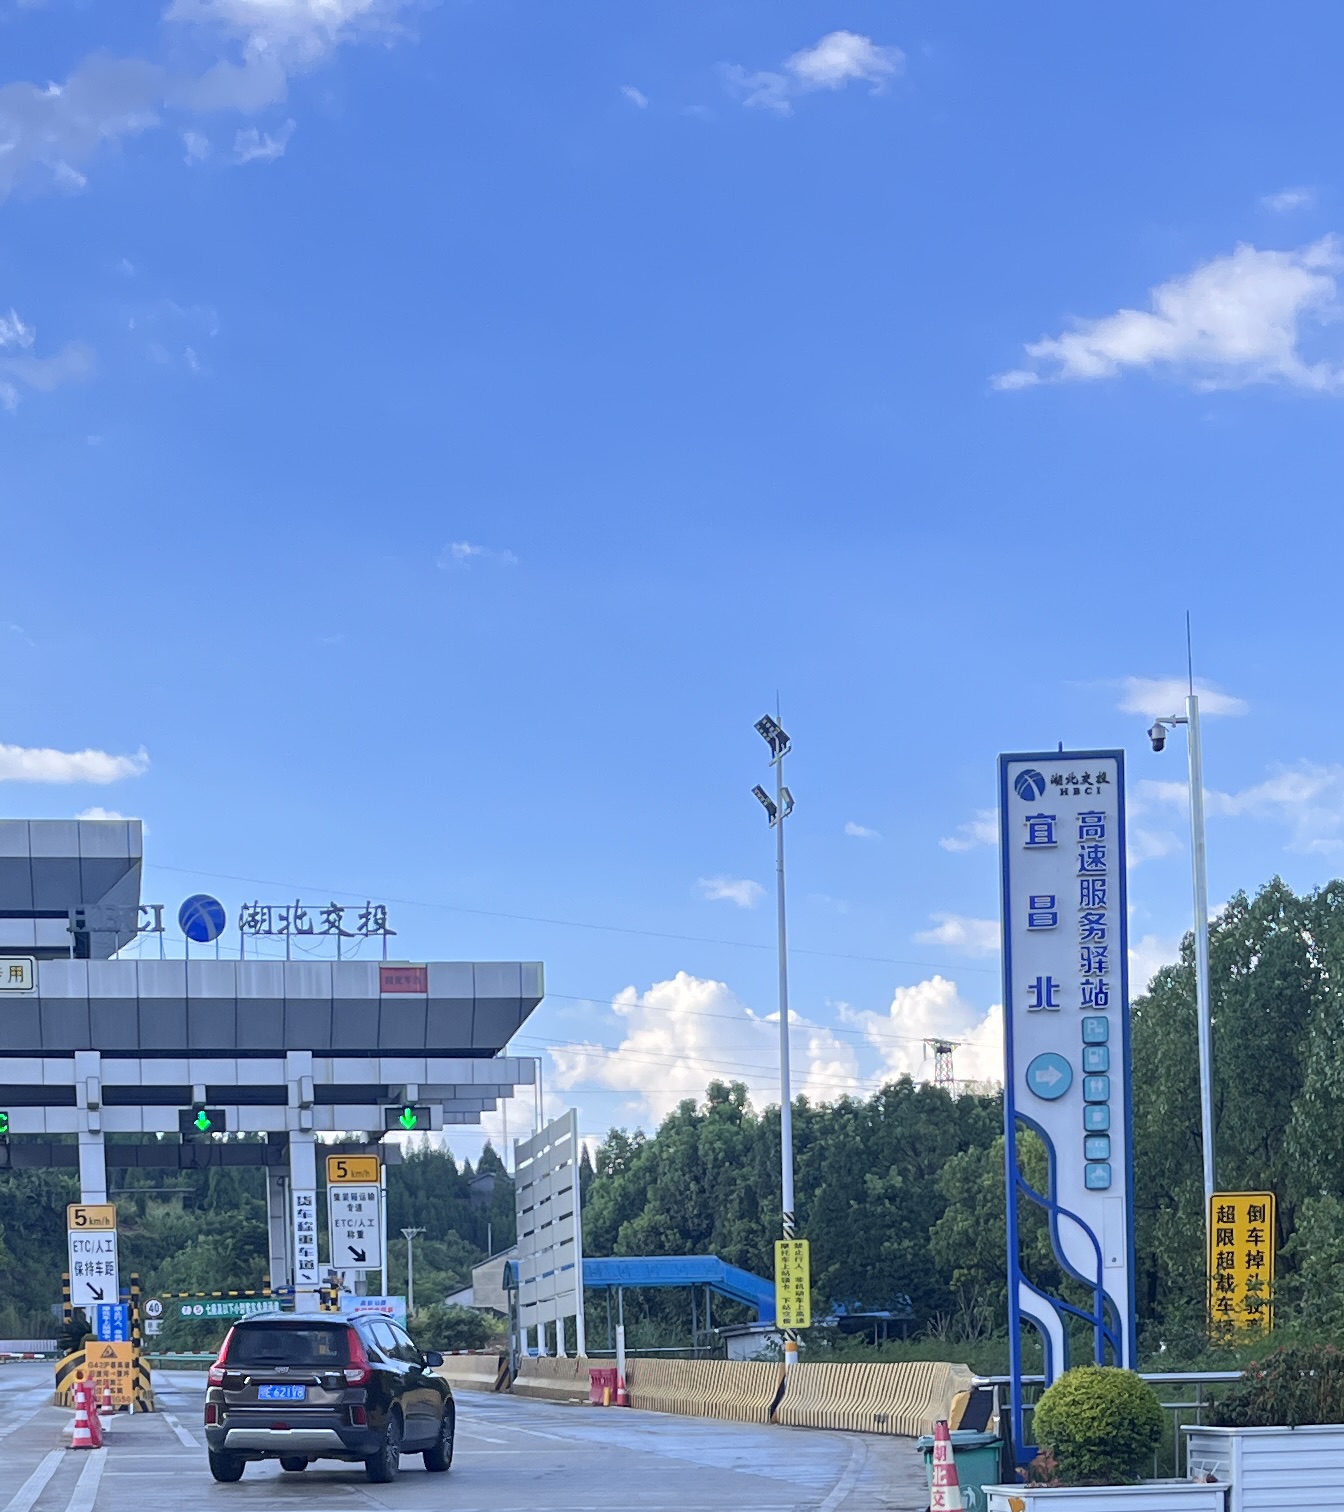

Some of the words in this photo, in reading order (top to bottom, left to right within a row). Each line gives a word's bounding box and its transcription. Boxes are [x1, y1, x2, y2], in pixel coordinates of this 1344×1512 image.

[1050, 771, 1110, 786] 湖北交投
[1060, 787, 1101, 796] HBCI
[1023, 813, 1060, 1010] 宜昌北
[1077, 810, 1110, 1009] 高速服务驿站
[238, 899, 397, 937] 湖北交投
[336, 1161, 348, 1178] 5
[74, 1209, 87, 1226] 5
[89, 1217, 111, 1226] km/h
[73, 1240, 114, 1253] ETC/人工
[74, 1261, 115, 1276] 保持车距
[148, 1303, 160, 1313] 40
